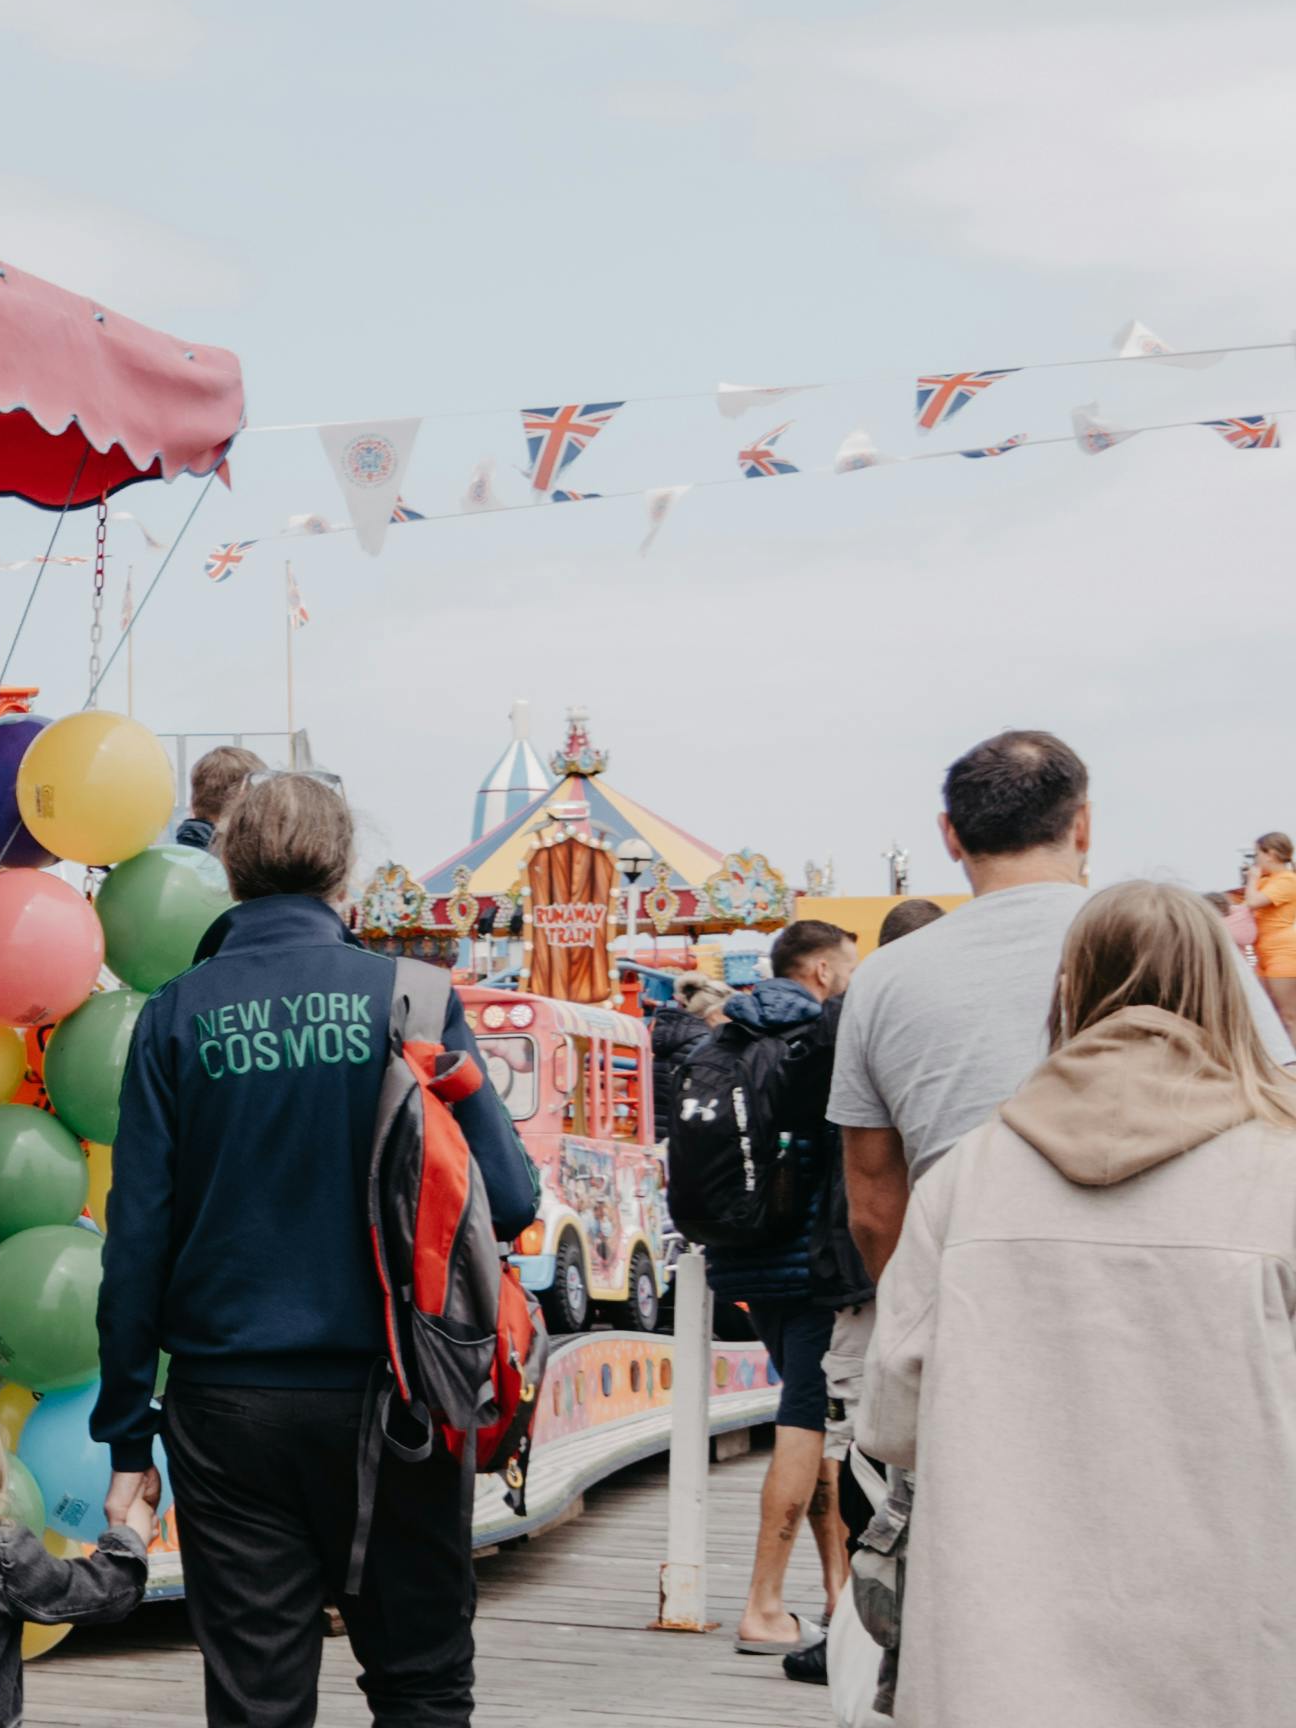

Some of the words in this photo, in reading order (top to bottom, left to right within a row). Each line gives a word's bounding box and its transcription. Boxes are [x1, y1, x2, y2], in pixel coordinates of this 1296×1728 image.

[534, 902, 607, 928] RUNAWAY
[546, 926, 595, 948] TRAIN
[195, 998, 271, 1039] NEW
[280, 991, 373, 1025] YORK
[198, 1022, 373, 1080] COSMOS
